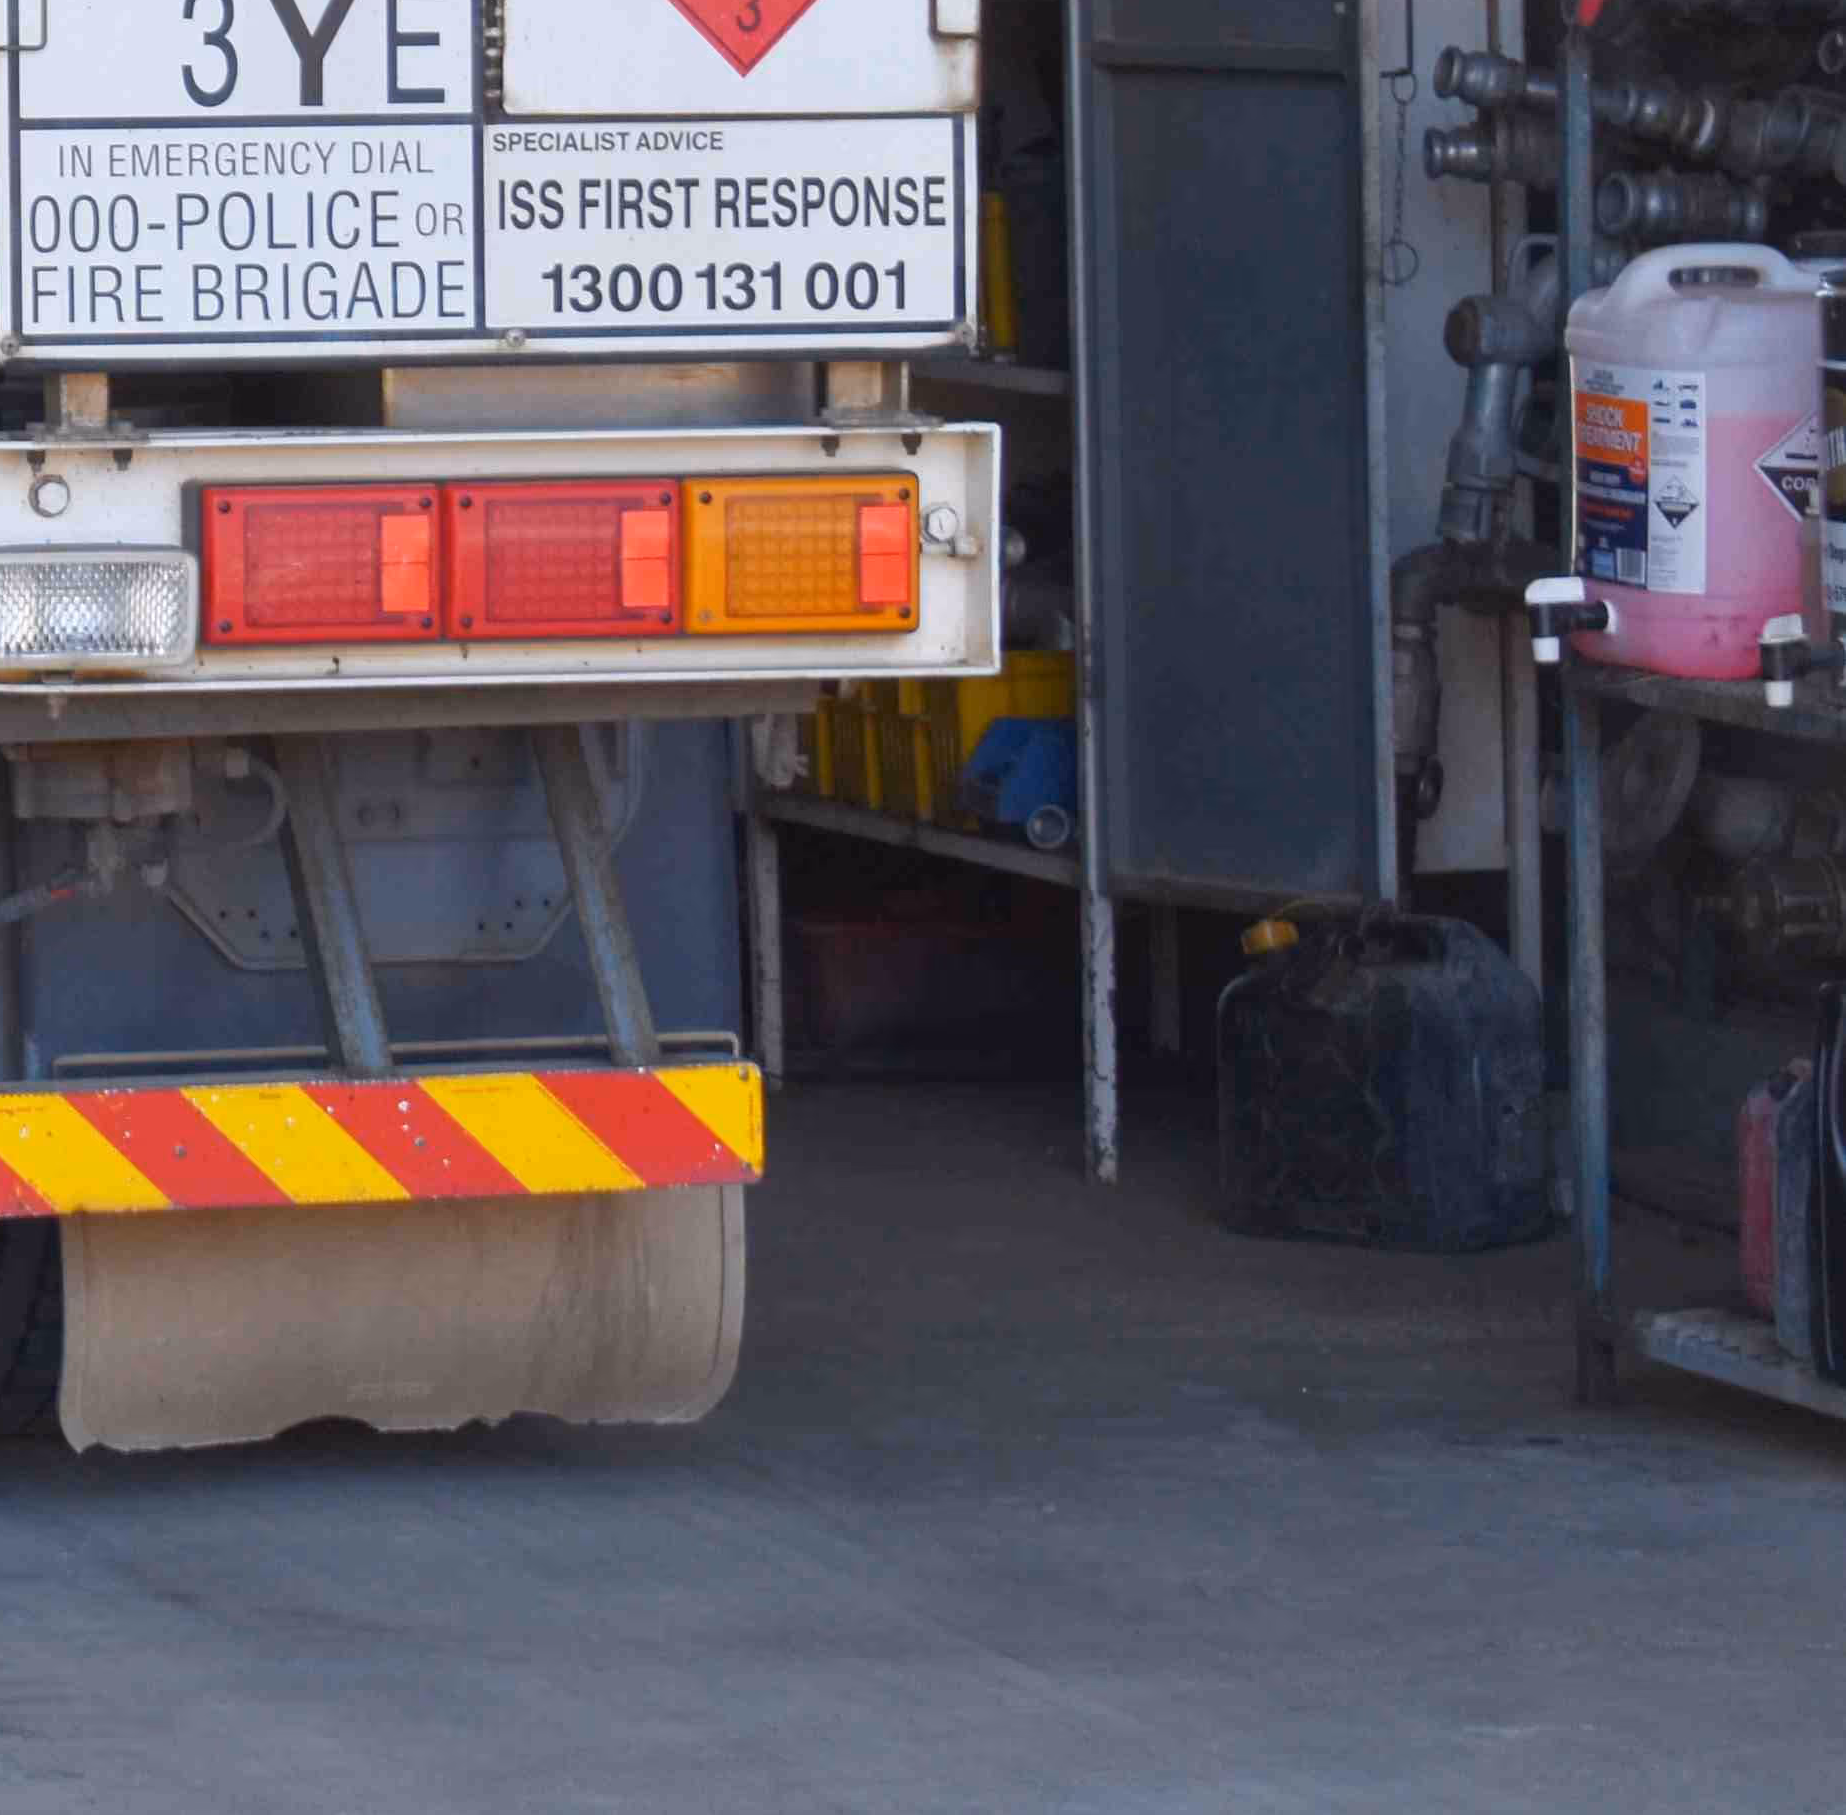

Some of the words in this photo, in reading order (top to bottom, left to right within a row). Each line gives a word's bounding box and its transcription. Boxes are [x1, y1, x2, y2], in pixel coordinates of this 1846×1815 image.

[59, 145, 92, 179] IN
[109, 142, 337, 179] EMERGENCY
[350, 140, 434, 176] DIAL
[493, 131, 631, 153] SPECIALIST
[635, 130, 723, 152] ADVICE
[415, 206, 464, 237] OR
[498, 180, 565, 231] ISS
[578, 179, 698, 230] FIRST
[713, 176, 946, 230] RESPONSE
[32, 265, 163, 325] FIRE
[195, 261, 466, 322] BRIGADE
[542, 263, 684, 313] 1300
[695, 262, 786, 313] 131
[804, 261, 907, 312] 001
[1586, 408, 1624, 427] SHOCK
